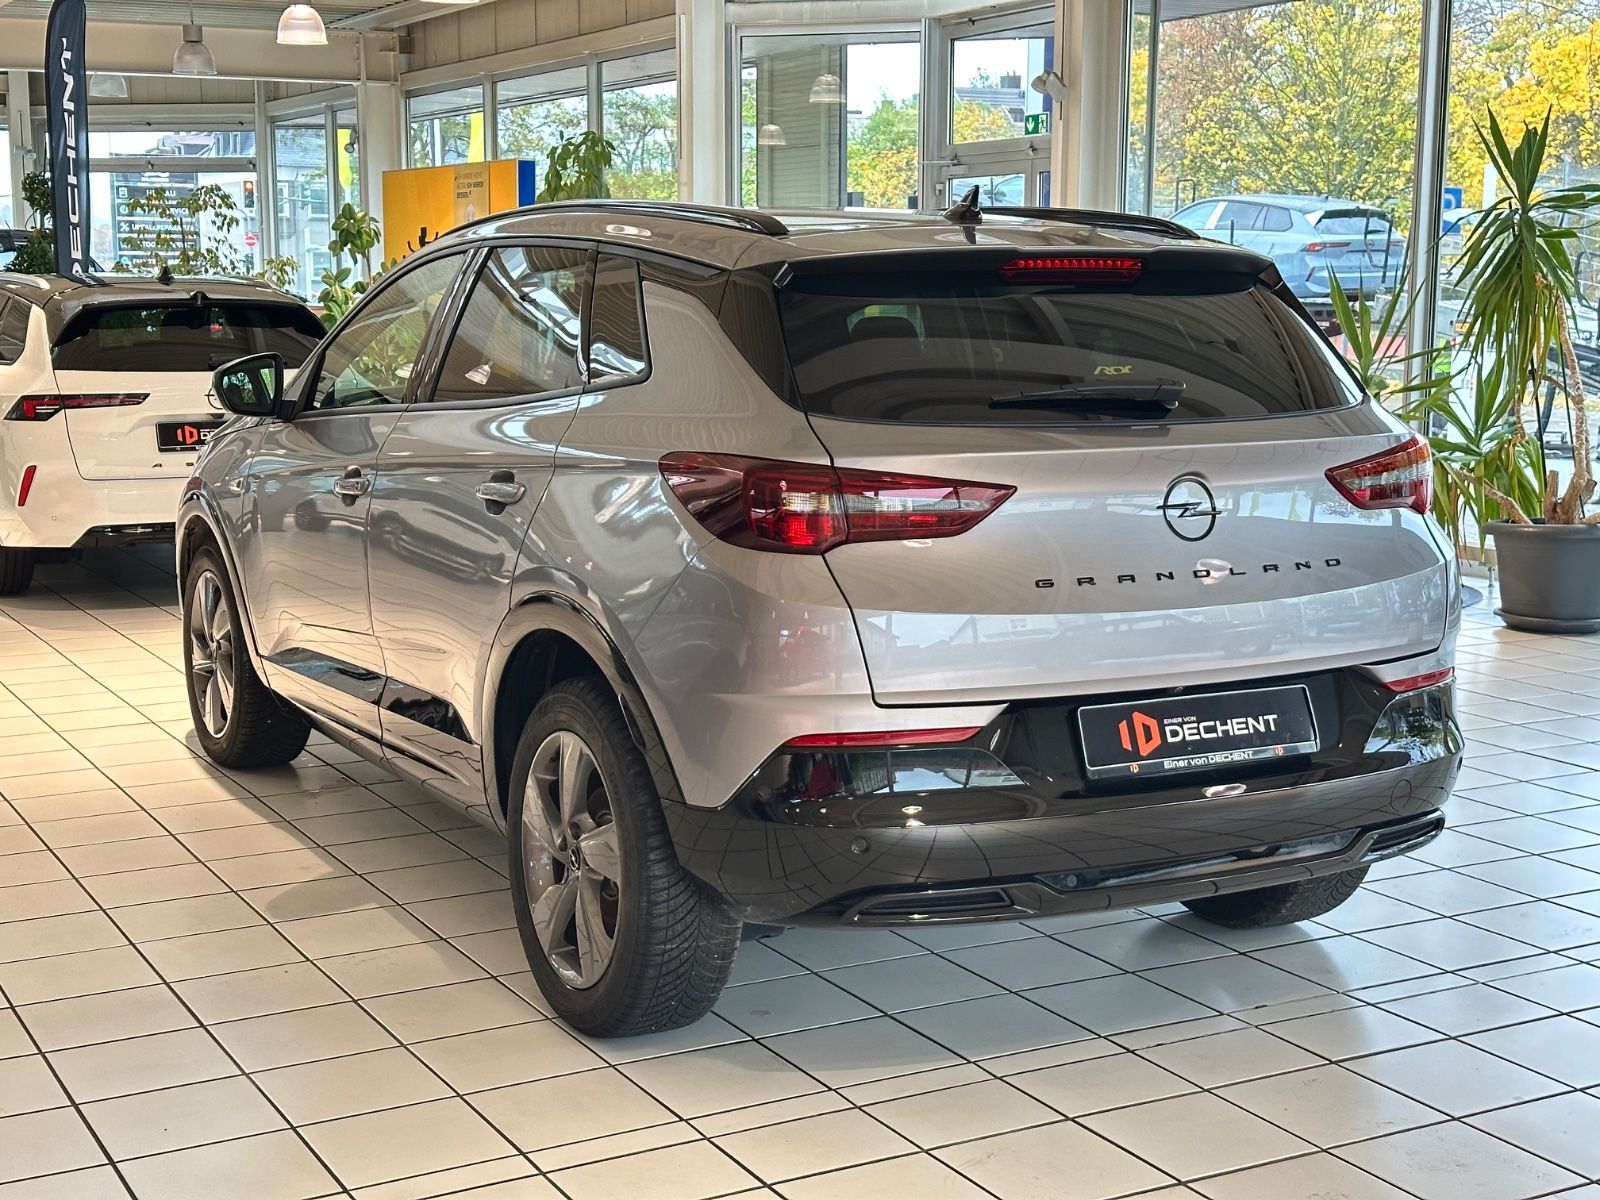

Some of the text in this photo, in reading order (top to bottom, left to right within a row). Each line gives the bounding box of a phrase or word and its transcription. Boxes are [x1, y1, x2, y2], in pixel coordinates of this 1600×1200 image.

[1035, 557, 1341, 589] GRANDLAND
[1165, 714, 1278, 743] DECHENT
[1164, 760, 1188, 769] Einer
[1189, 758, 1208, 766] von
[1209, 750, 1254, 764] DECHENT
